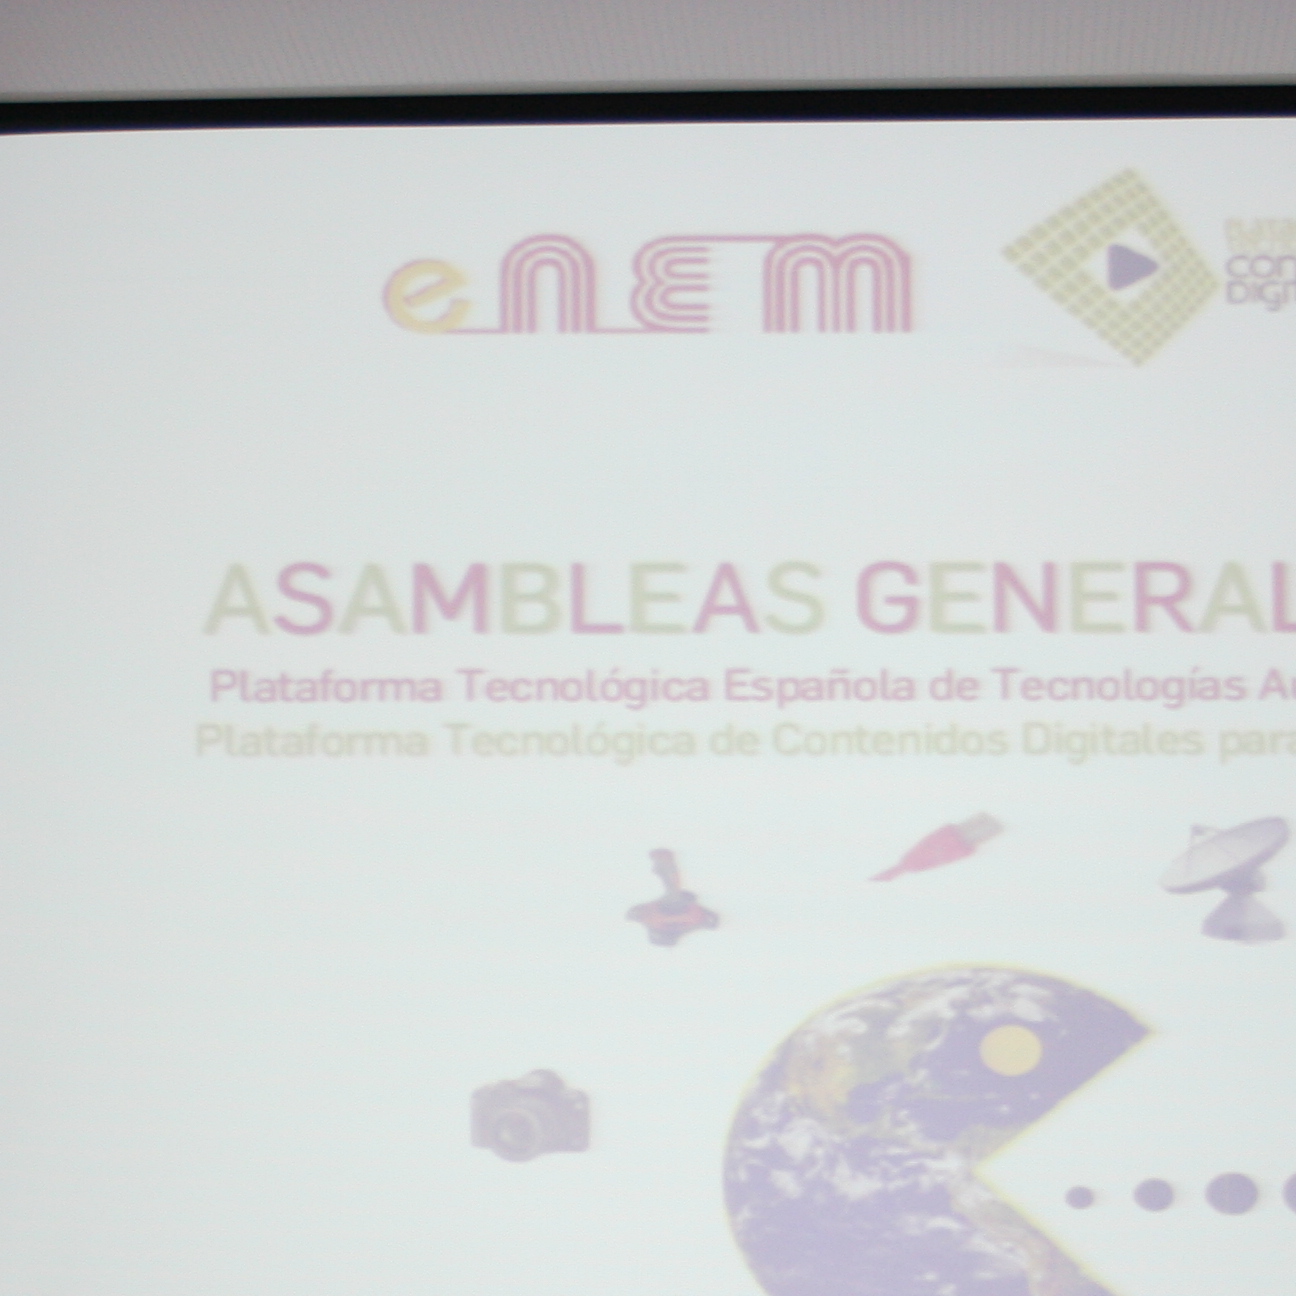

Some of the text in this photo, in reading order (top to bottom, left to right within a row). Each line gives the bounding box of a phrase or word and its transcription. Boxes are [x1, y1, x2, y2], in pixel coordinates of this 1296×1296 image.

[203, 561, 826, 635] ASAMBLEAS
[210, 669, 442, 702] Plataforma
[456, 668, 709, 711] Tecnológica
[724, 667, 916, 709] Española
[928, 668, 979, 701] de
[990, 666, 1247, 709] Tecnologías
[196, 723, 429, 757] Plataforma
[444, 723, 694, 765] Tecnológica
[709, 722, 760, 757] de
[772, 722, 1005, 757] Contenidos
[1022, 722, 1203, 764] Digitales
